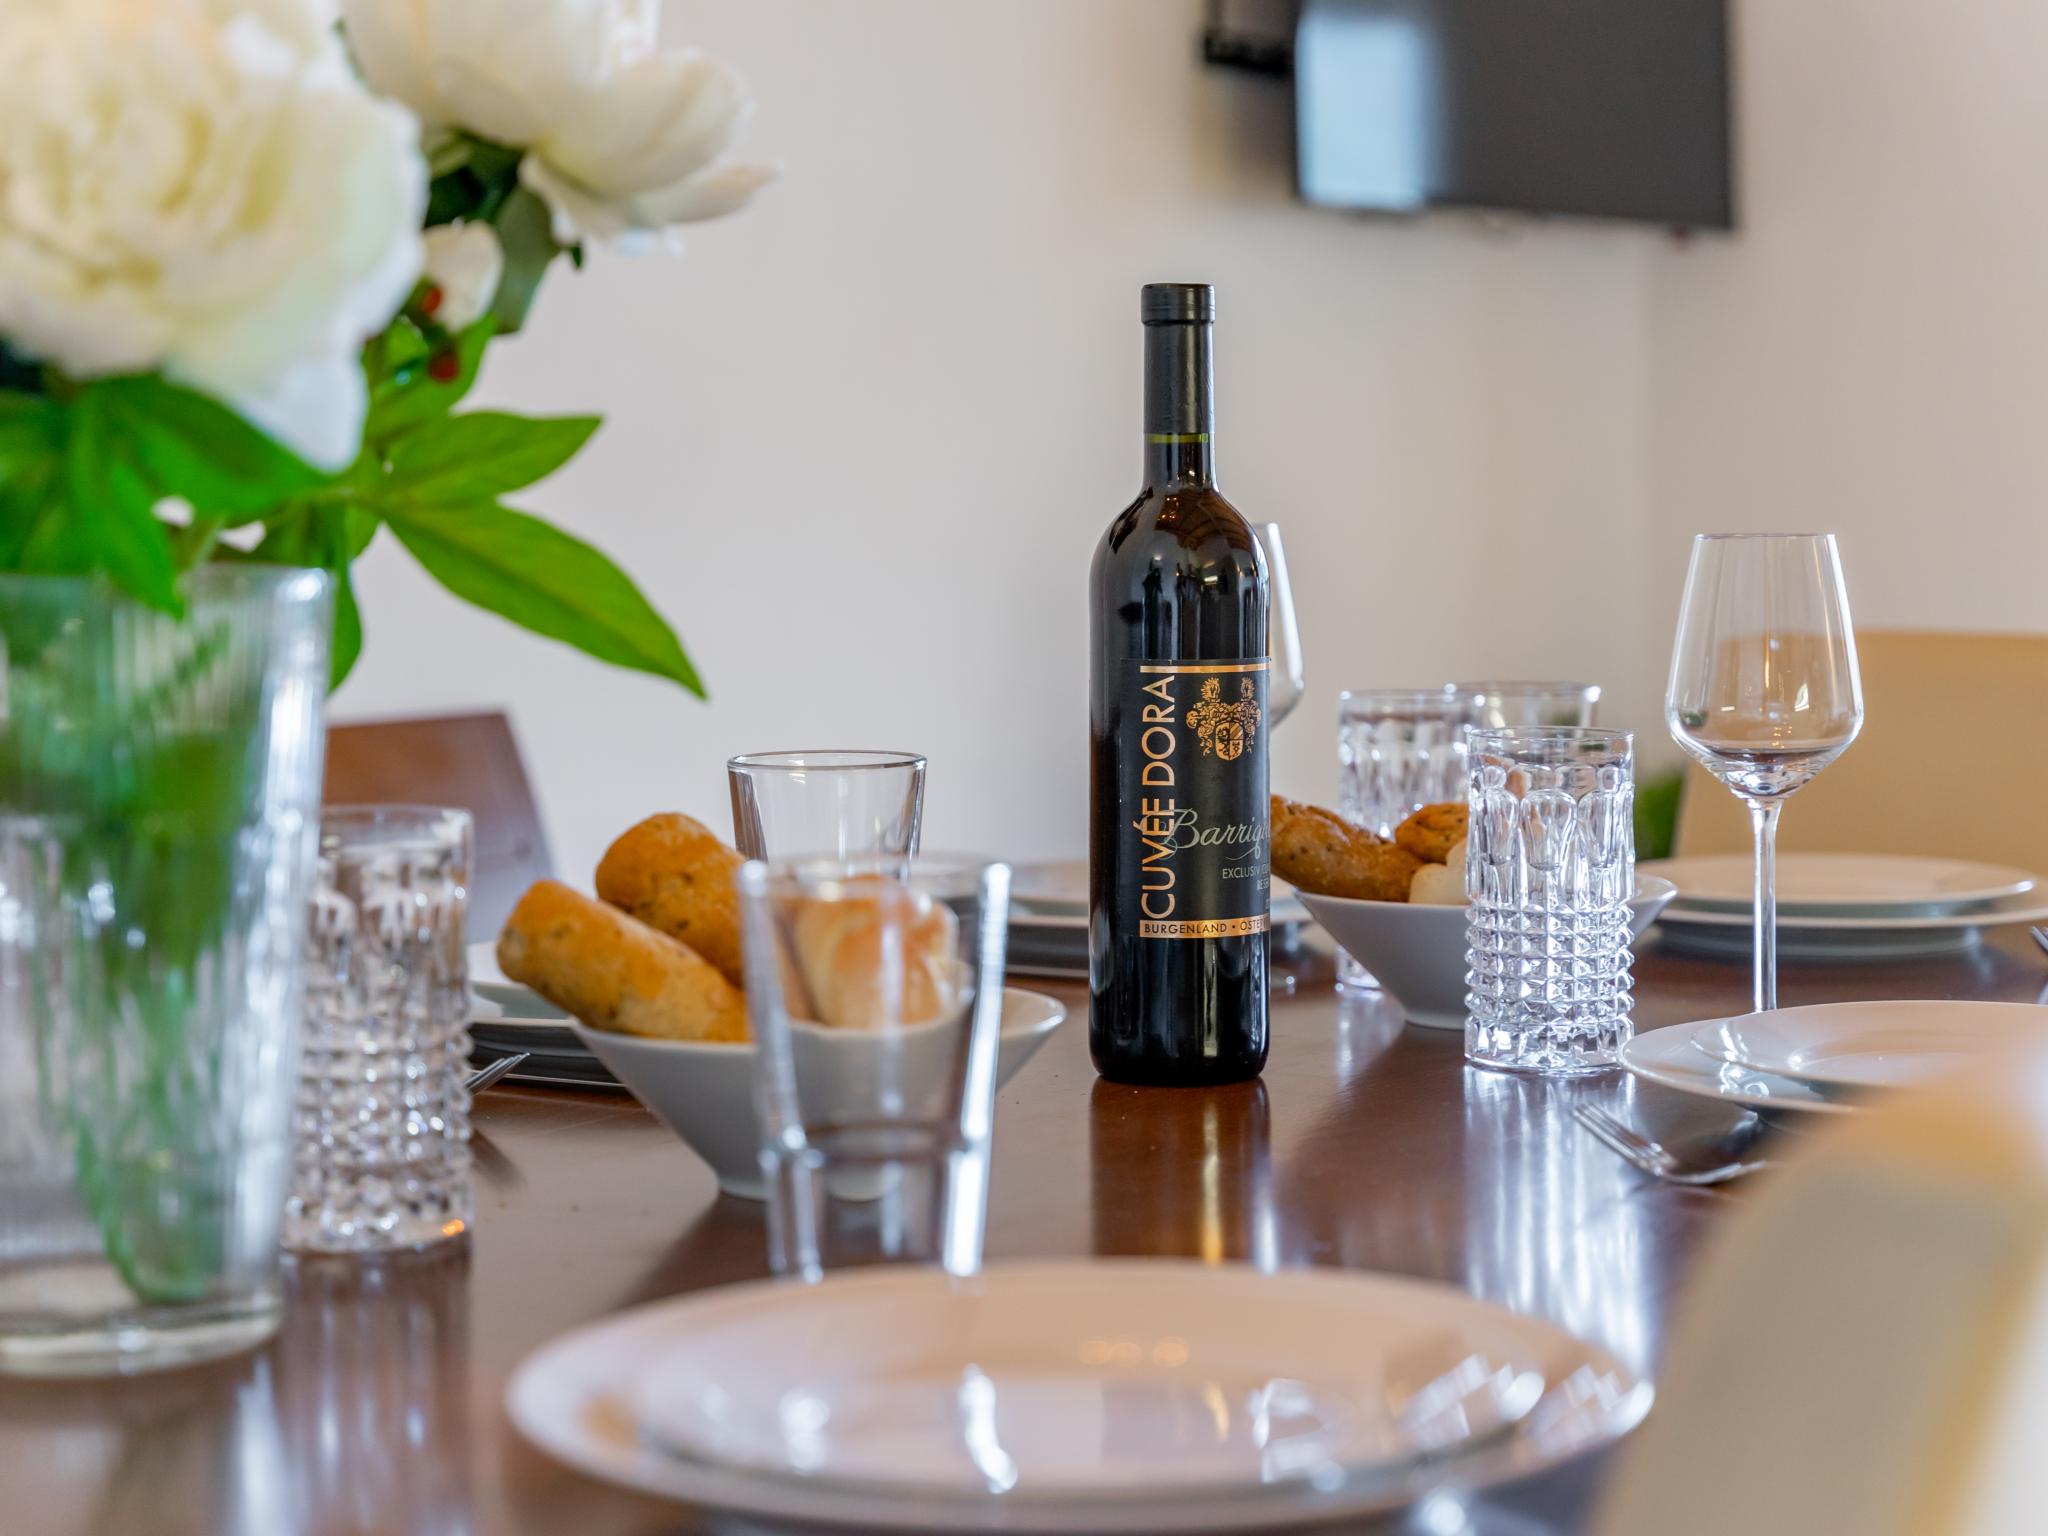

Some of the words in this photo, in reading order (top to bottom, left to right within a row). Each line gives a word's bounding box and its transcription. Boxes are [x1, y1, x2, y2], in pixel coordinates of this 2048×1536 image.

[1141, 674, 1176, 786] DORA
[1133, 797, 1175, 919] CUVÉE
[1144, 922, 1227, 934] BURGENLAND
